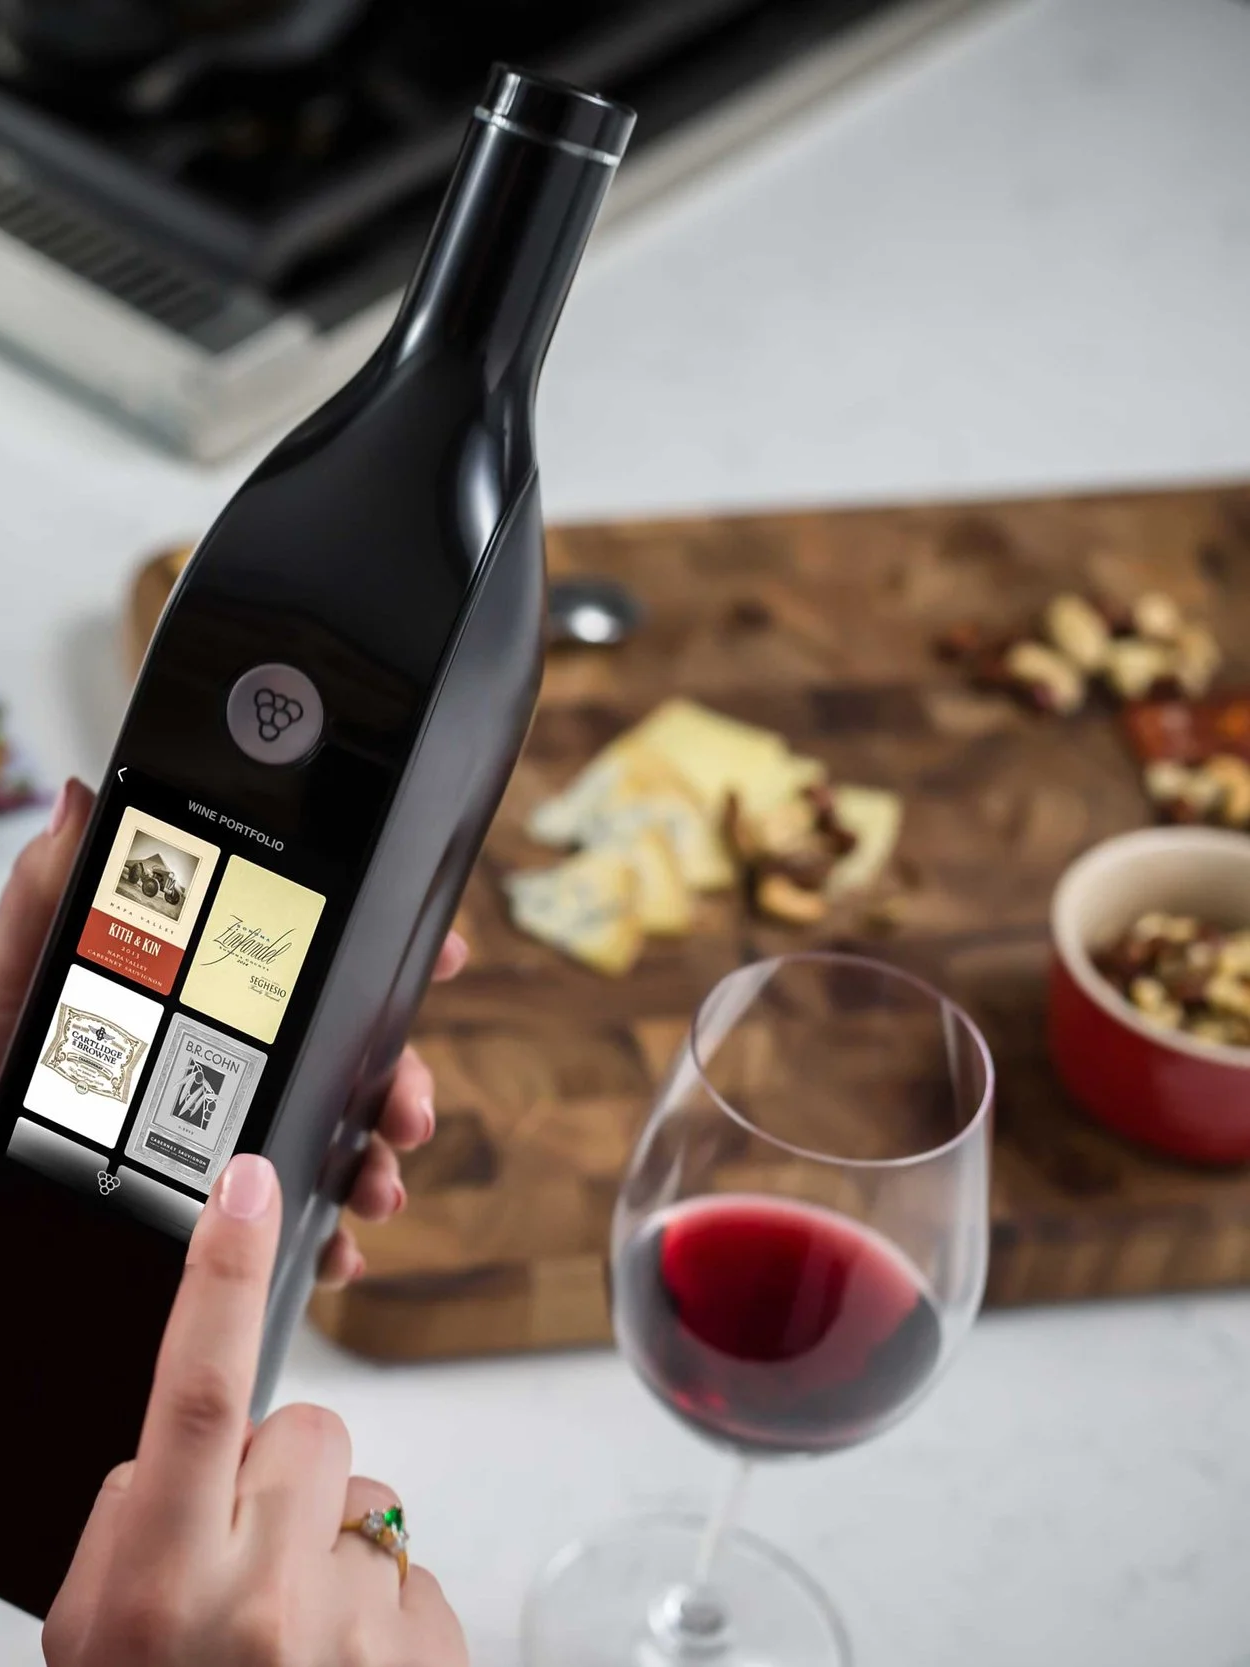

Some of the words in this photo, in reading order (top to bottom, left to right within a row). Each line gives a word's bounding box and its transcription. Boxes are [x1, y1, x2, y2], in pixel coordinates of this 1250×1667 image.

[185, 799, 218, 821] WINE
[218, 814, 285, 852] PORTFOLIO
[107, 922, 134, 944] KITH
[132, 935, 142, 947] &
[140, 937, 162, 957] KIN
[120, 946, 140, 959] 2013
[87, 948, 122, 967] CABERNET
[124, 965, 162, 986] SAUVIGNON
[106, 949, 124, 961] NAPA
[124, 957, 147, 972] VALLEY
[248, 974, 287, 998] SEGHESIO
[70, 1030, 124, 1060] CARTLIDGE
[76, 1041, 117, 1065] BROWNE
[149, 1136, 176, 1152] CABERNET
[177, 1149, 207, 1166] SAUVIGNON
